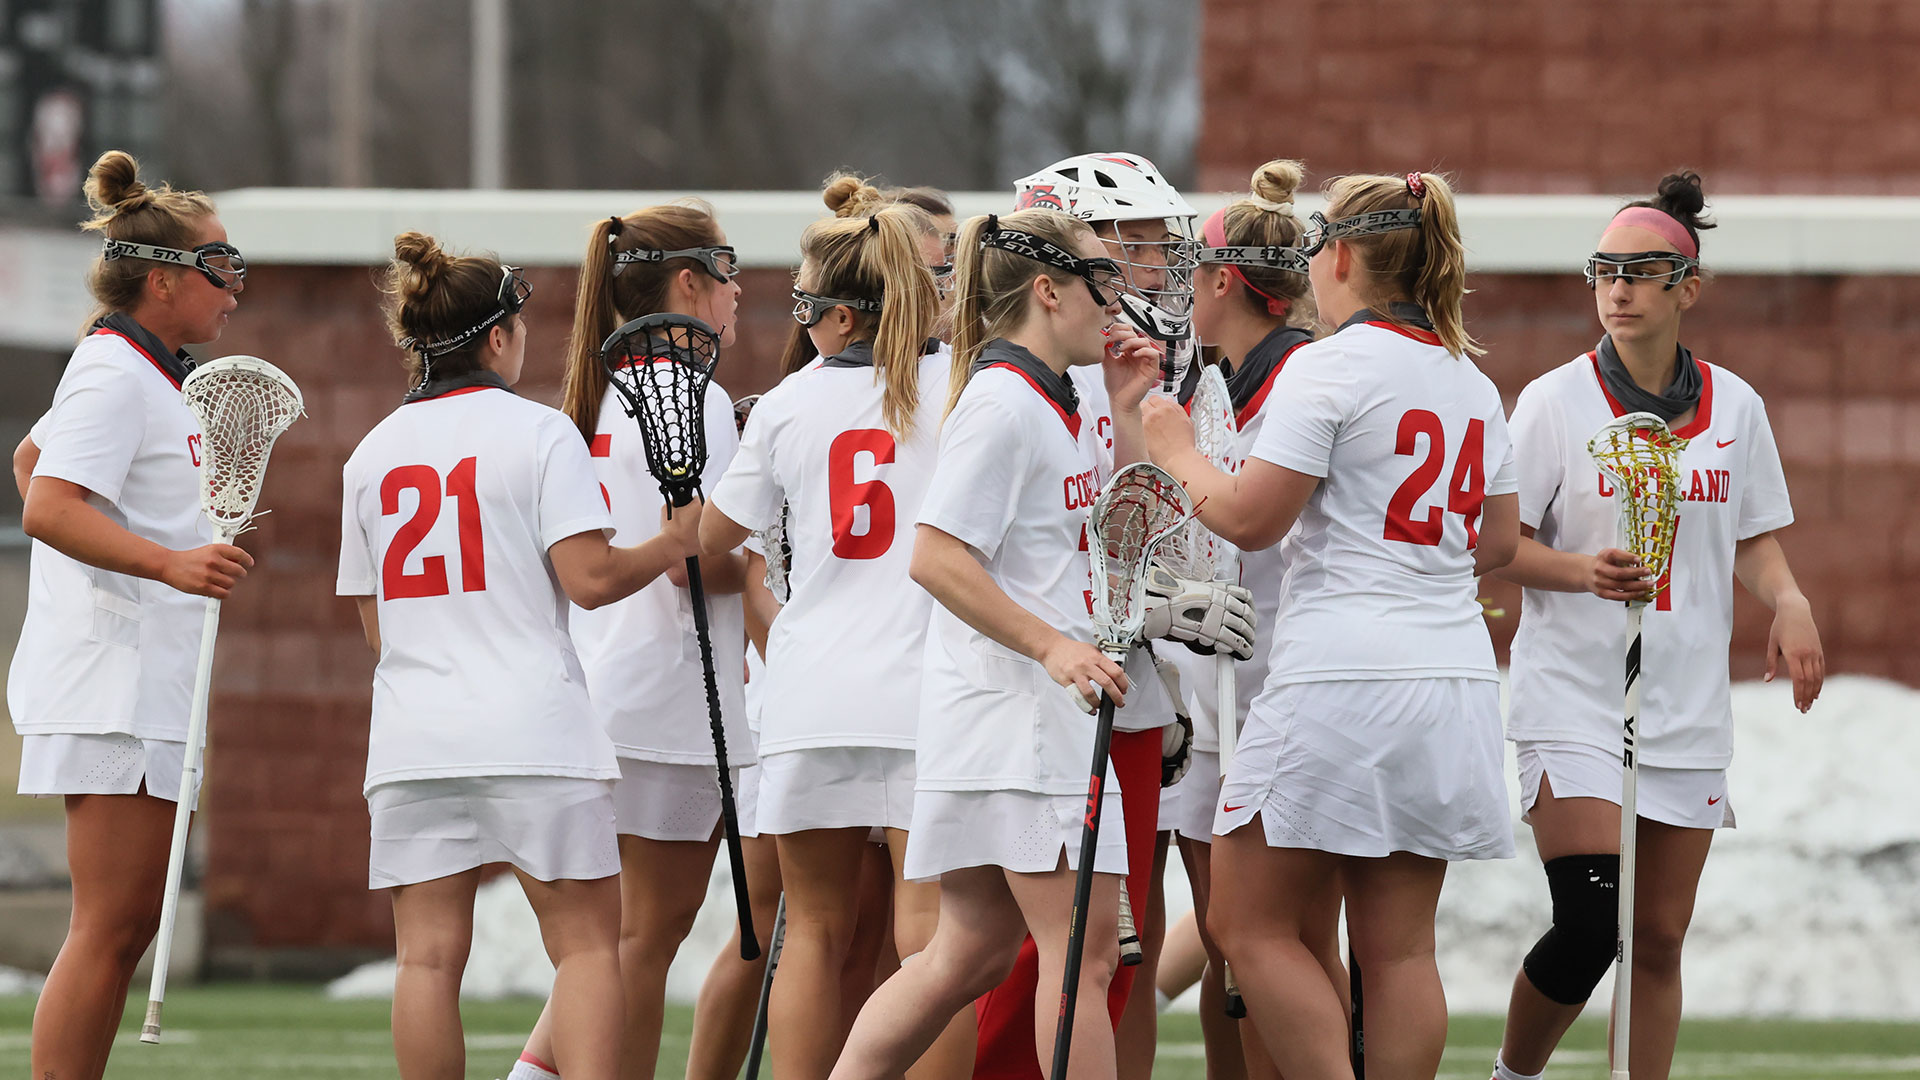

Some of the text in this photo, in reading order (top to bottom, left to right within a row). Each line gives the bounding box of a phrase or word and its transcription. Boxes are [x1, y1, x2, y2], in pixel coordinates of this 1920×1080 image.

[1367, 210, 1402, 224] STX
[998, 230, 1033, 244] STX
[152, 249, 183, 262] STX
[1003, 241, 1040, 259] STX
[1041, 242, 1079, 268] STX
[1214, 248, 1246, 259] STX
[426, 334, 464, 349] ARMOUR
[477, 308, 506, 330] UNDER
[1383, 408, 1486, 550] 24
[828, 428, 895, 559] 6
[380, 456, 487, 601] 21
